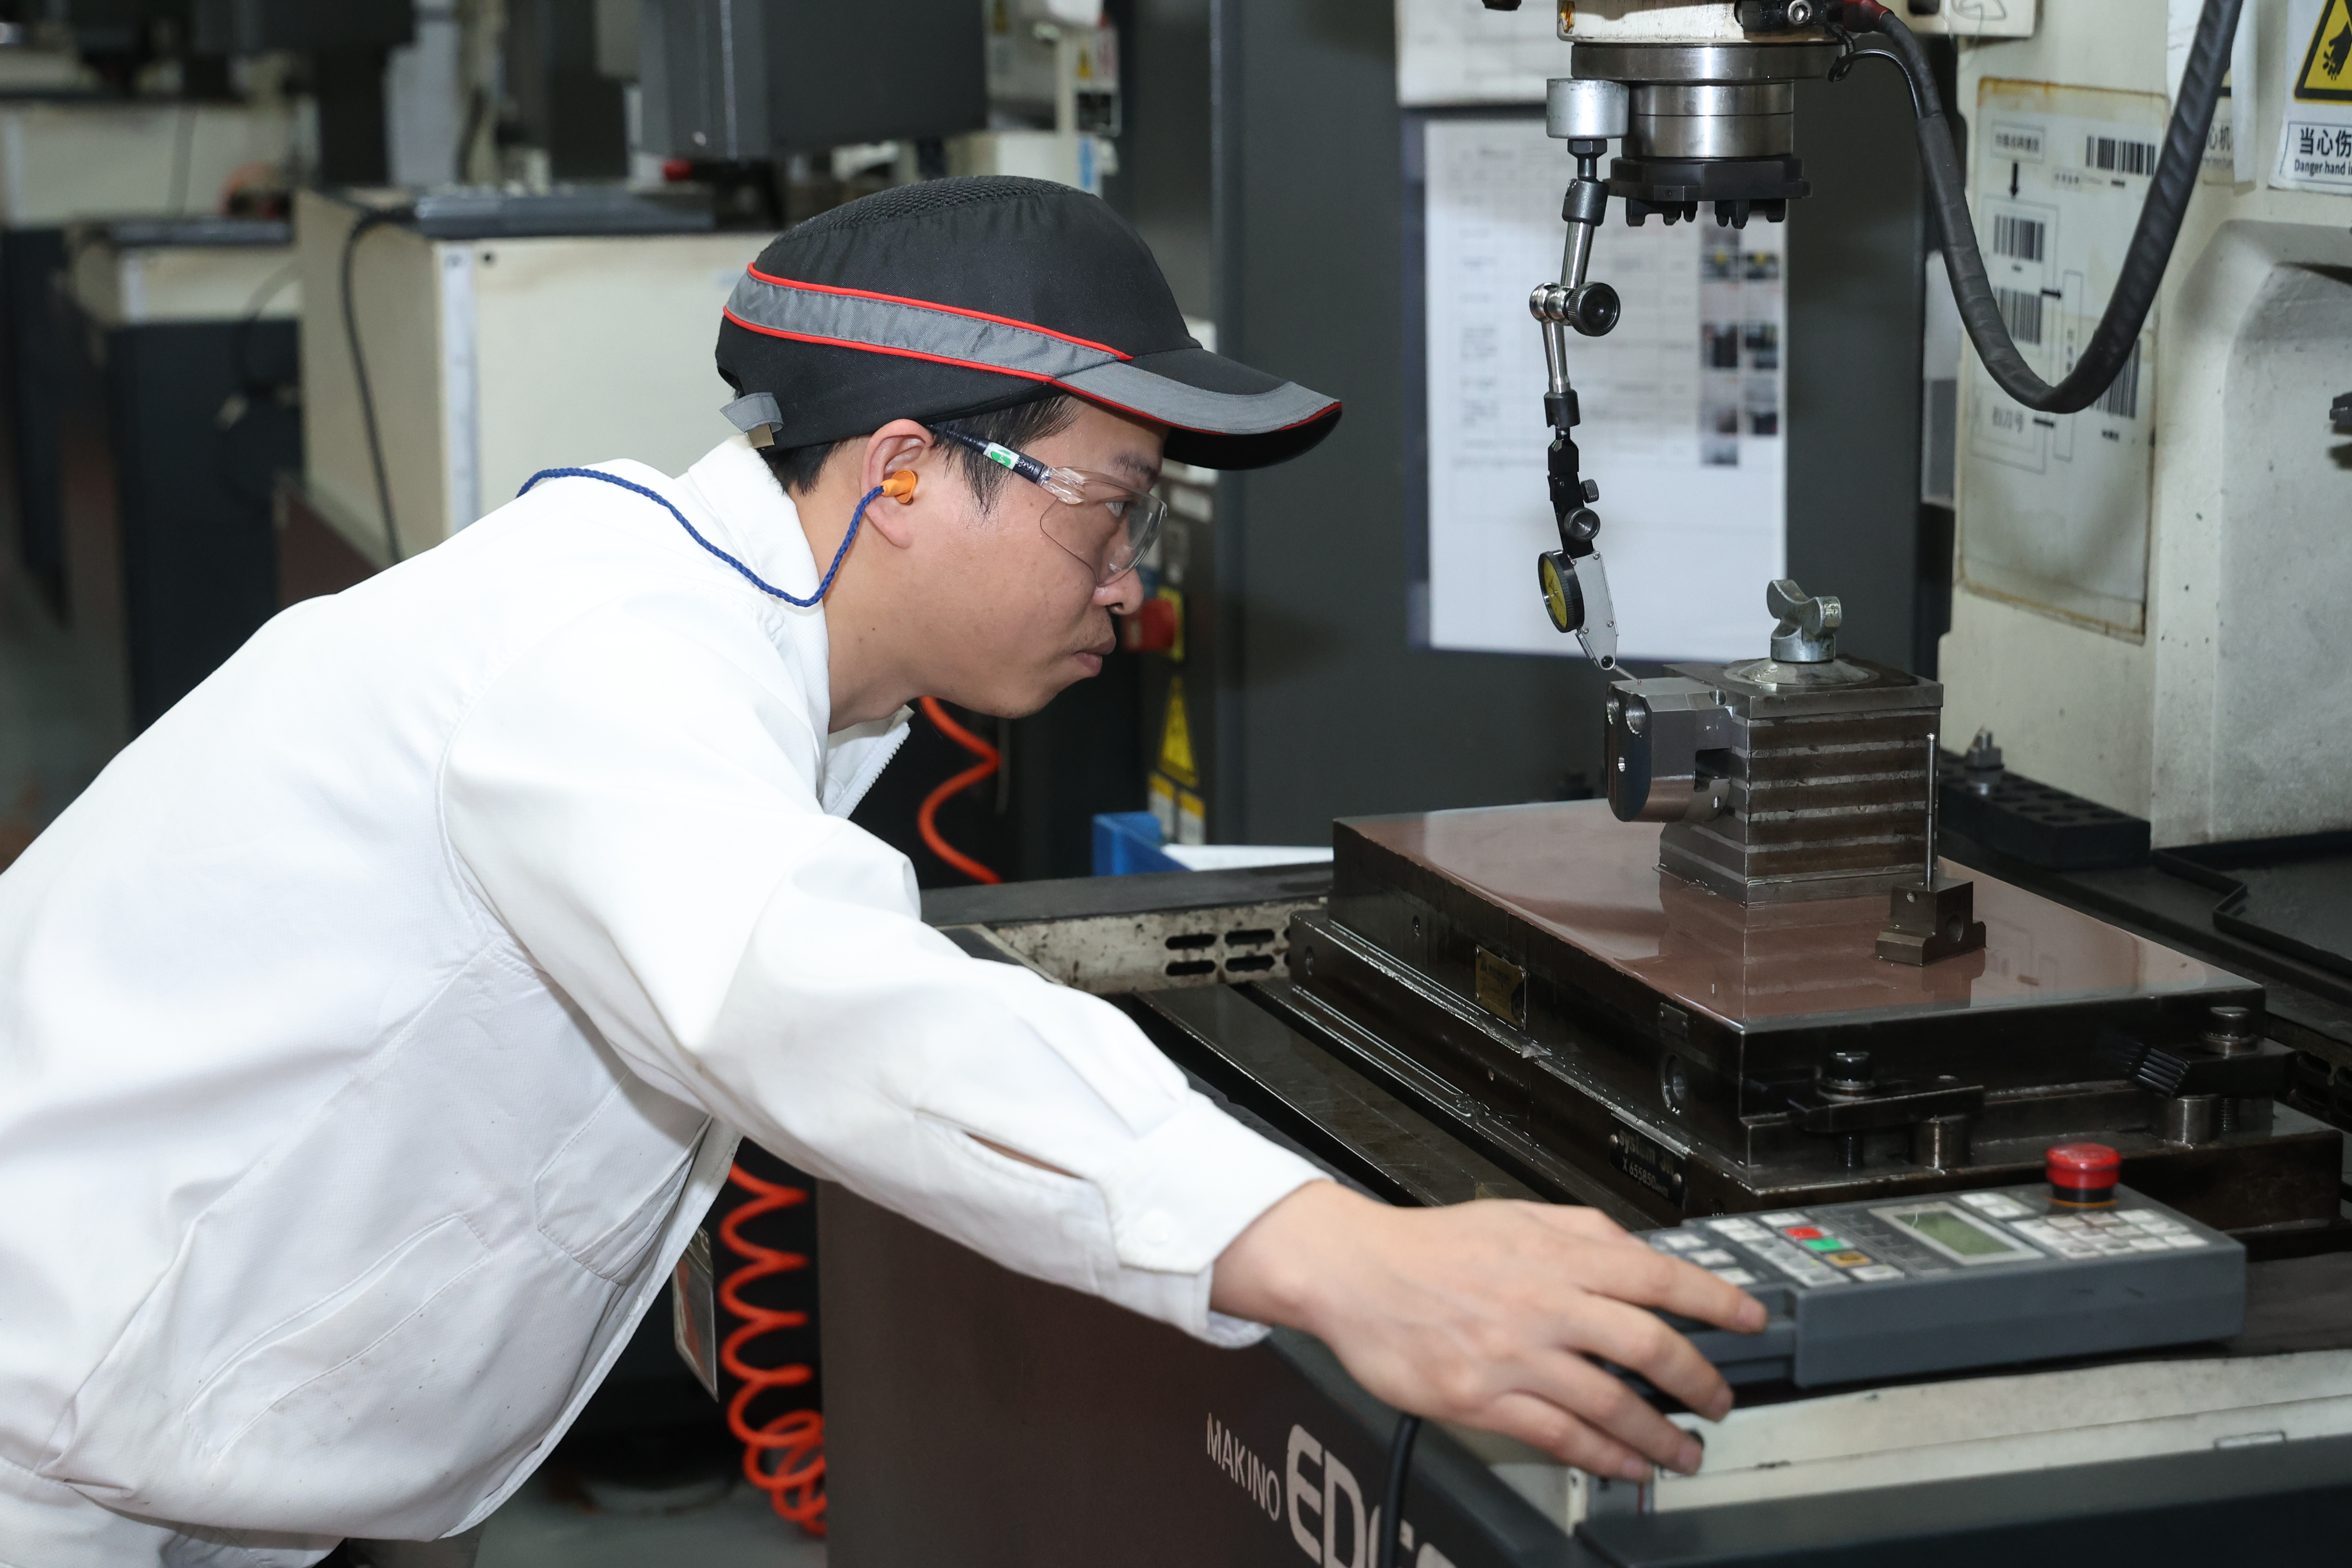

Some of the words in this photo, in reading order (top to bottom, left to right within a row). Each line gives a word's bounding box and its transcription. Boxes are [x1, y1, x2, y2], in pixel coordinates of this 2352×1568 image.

[2294, 159, 2322, 177] Danger
[2325, 160, 2346, 175] hand
[1207, 1412, 1281, 1521] MAKINO
